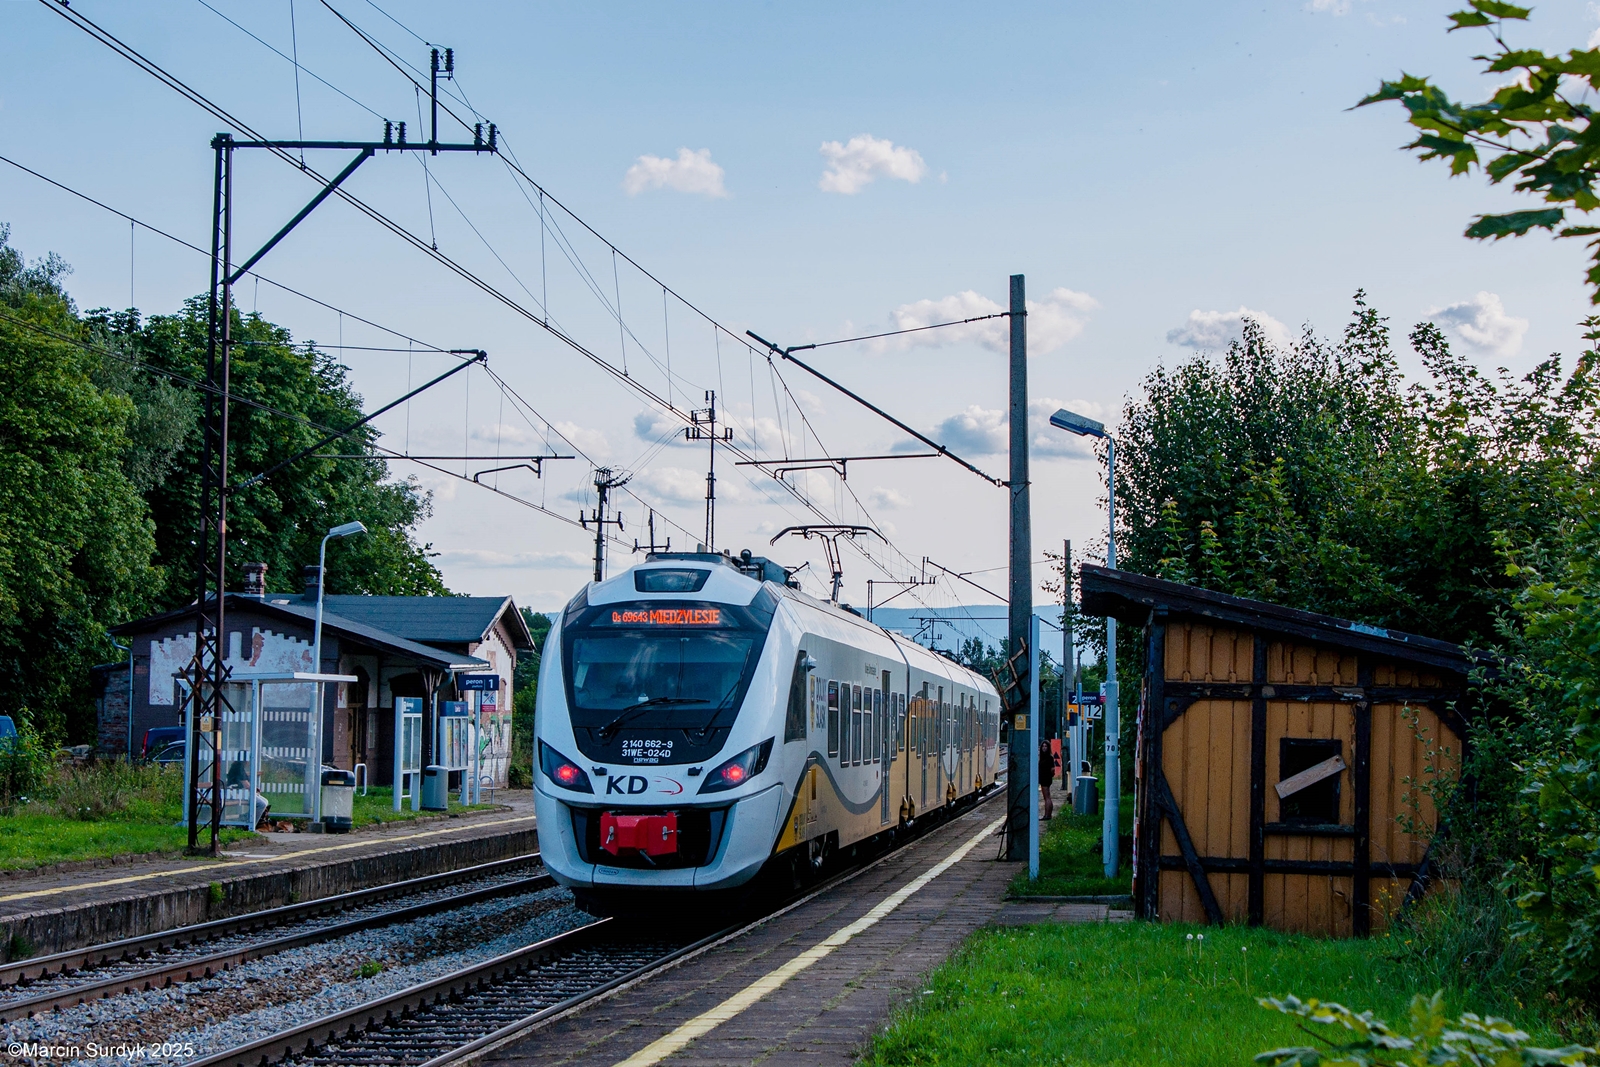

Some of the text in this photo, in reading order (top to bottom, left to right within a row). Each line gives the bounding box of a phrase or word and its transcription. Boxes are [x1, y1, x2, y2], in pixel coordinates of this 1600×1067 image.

[622, 611, 648, 622] 69643
[488, 679, 494, 689] 1
[1072, 695, 1078, 704] 2
[1087, 705, 1101, 717] 12
[622, 739, 673, 749] 2 140 662-9
[622, 749, 671, 758] 31WE-024D
[606, 775, 648, 795] KD
